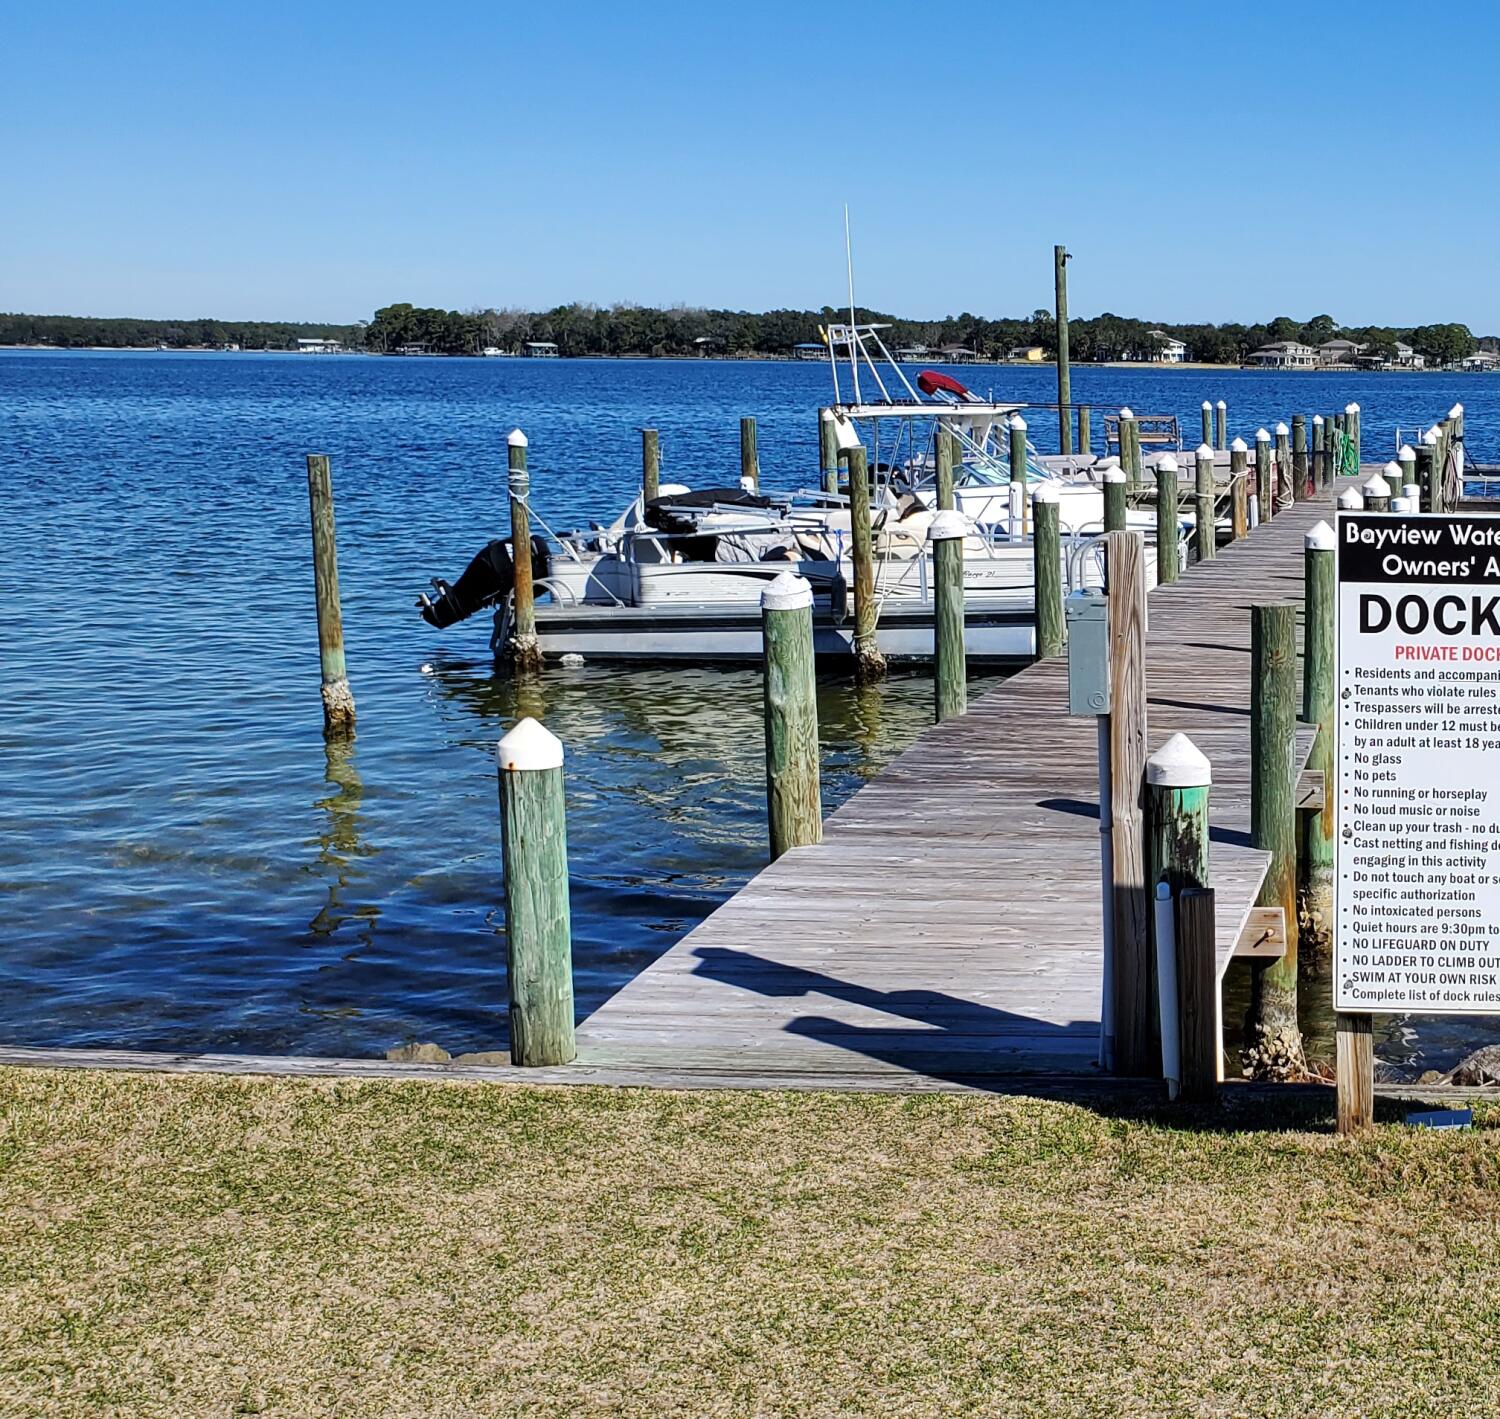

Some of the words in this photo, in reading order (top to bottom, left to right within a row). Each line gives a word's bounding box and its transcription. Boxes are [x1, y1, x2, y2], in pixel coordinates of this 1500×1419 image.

[1345, 521, 1442, 550] Bayview
[1381, 553, 1476, 577] Owners'
[1394, 644, 1459, 661] PRIVATE
[1354, 666, 1411, 680] Residents
[1413, 667, 1435, 680] and
[1353, 683, 1399, 697] Tenants
[1400, 684, 1425, 697] who
[1426, 685, 1465, 698] violate
[1467, 685, 1497, 698] rules
[1353, 700, 1422, 716] Trespassers
[1423, 702, 1444, 714] will
[1446, 702, 1461, 715] be
[1353, 717, 1402, 731] Children
[1404, 719, 1439, 731] under
[1441, 719, 1456, 732] 12
[1458, 720, 1488, 732] must
[1353, 734, 1367, 749] by
[1368, 737, 1384, 747] an
[1385, 735, 1416, 748] adult
[1418, 736, 1431, 748] at
[1432, 736, 1462, 749] least
[1464, 736, 1480, 749] 18
[1353, 751, 1370, 764] No
[1371, 752, 1402, 767] glass
[1353, 768, 1369, 781] No
[1371, 769, 1397, 783] pets
[1353, 785, 1369, 798] No
[1371, 786, 1416, 801] running
[1417, 789, 1430, 799] or
[1431, 787, 1488, 802] horseplay
[1353, 803, 1369, 815] No
[1371, 803, 1396, 815] loud
[1398, 803, 1433, 816] music
[1435, 806, 1448, 816] or
[1449, 804, 1480, 817] noise
[1352, 819, 1386, 832] Clean
[1388, 822, 1403, 835] up
[1404, 823, 1431, 835] your
[1432, 821, 1462, 834] trash
[1471, 824, 1486, 834] no
[1352, 836, 1380, 849] Cast
[1381, 837, 1423, 852] netting
[1424, 838, 1447, 850] and
[1448, 837, 1489, 854] fishing
[1352, 853, 1406, 869] engaging
[1407, 854, 1419, 866] in
[1421, 854, 1443, 867] this
[1445, 855, 1487, 870] activity
[1352, 870, 1368, 882] Do
[1370, 871, 1390, 883] not
[1391, 871, 1425, 883] touch
[1426, 873, 1447, 886] any
[1449, 872, 1476, 885] boat
[1477, 875, 1490, 885] or
[1352, 887, 1398, 901] specific
[1399, 888, 1476, 901] authorization
[1352, 903, 1368, 916] No
[1370, 904, 1434, 917] intoxicated
[1436, 908, 1482, 920] persons
[1352, 920, 1383, 935] Quiet
[1385, 921, 1418, 934] hours
[1419, 924, 1439, 934] are
[1440, 922, 1486, 937] 9:30pm
[1487, 923, 1500, 935] to
[1352, 937, 1369, 949] NO
[1371, 937, 1437, 951] LIFEGUARD
[1439, 939, 1456, 951] ON
[1459, 939, 1490, 952] DUTY
[1351, 954, 1369, 966] NO
[1371, 954, 1417, 967] LADDER
[1419, 955, 1435, 967] TO
[1437, 955, 1475, 968] CLIMB
[1352, 970, 1385, 983] SWIM
[1387, 971, 1402, 984] AT
[1404, 971, 1436, 985] YOUR
[1438, 972, 1466, 985] OWN
[1468, 973, 1497, 985] RISK
[1351, 987, 1406, 1002] Complete
[1408, 988, 1427, 1001] list
[1428, 988, 1441, 1001] of
[1442, 989, 1471, 1002] dock
